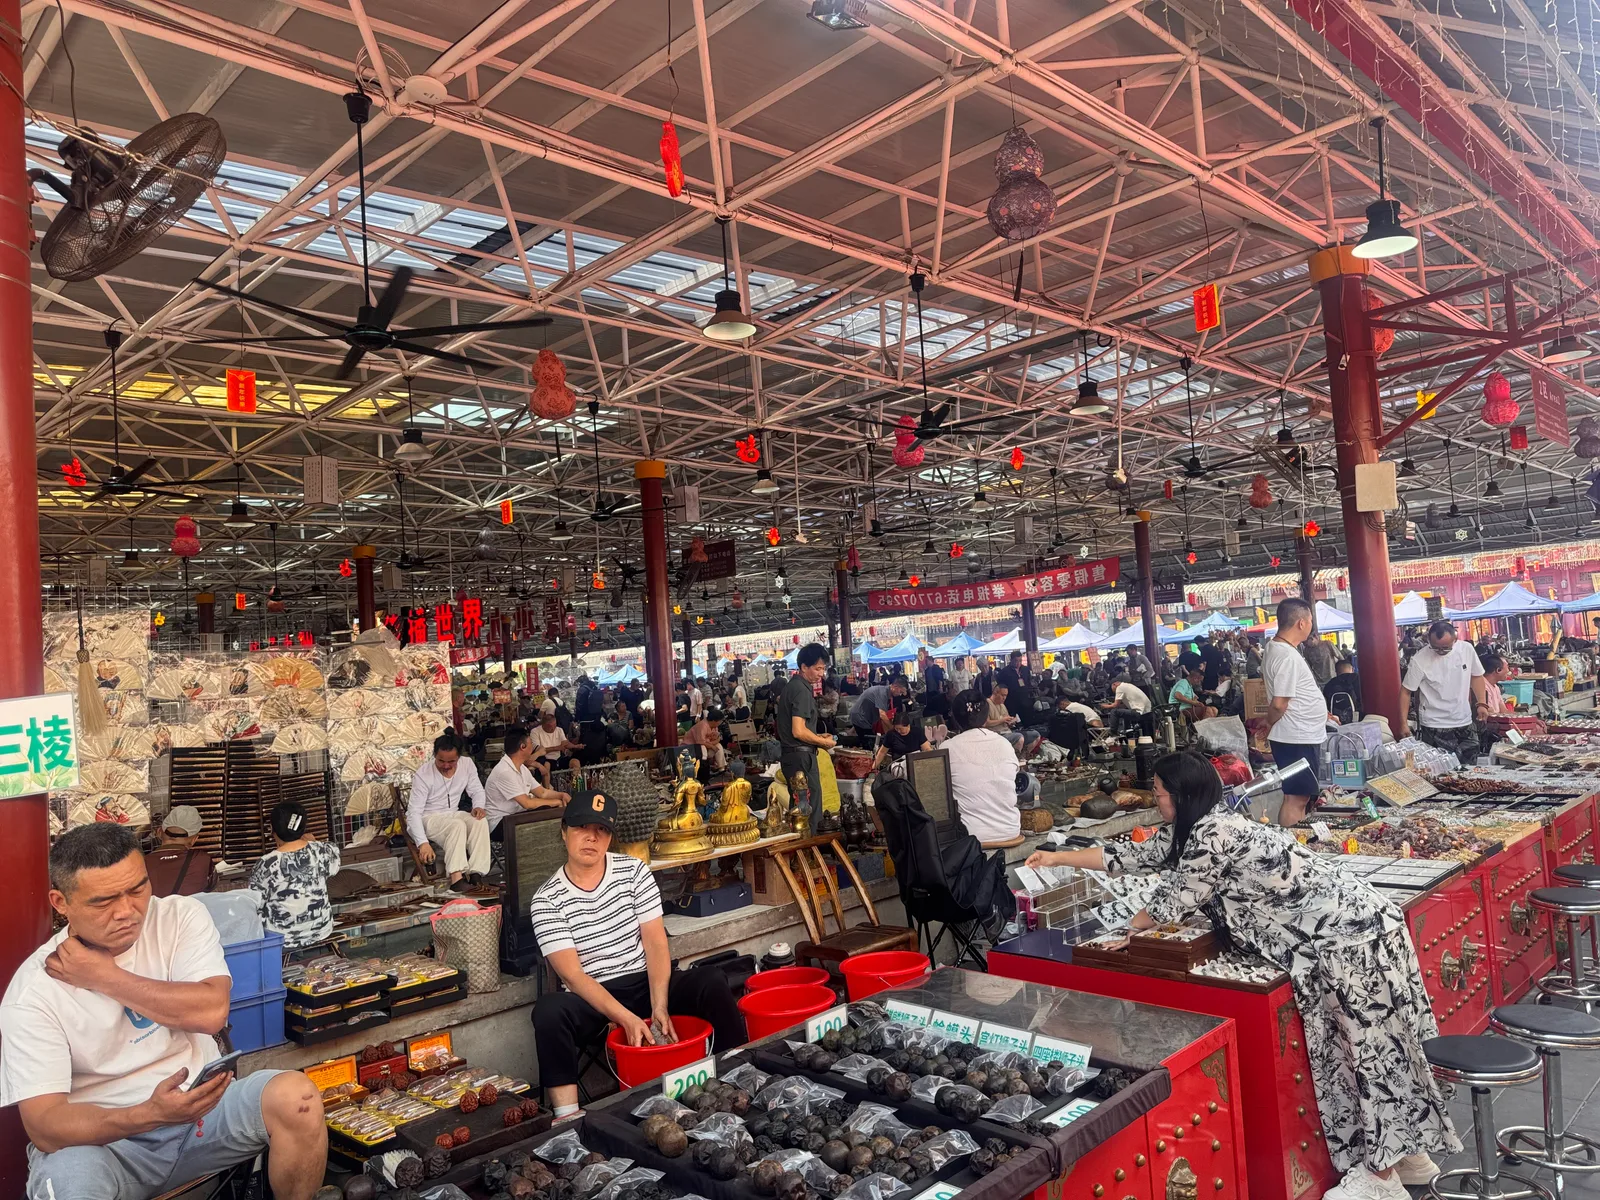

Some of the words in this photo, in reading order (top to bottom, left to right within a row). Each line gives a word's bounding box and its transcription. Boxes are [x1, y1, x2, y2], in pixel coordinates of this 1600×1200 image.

[0, 714, 75, 775] 三棱
[592, 794, 606, 812] G
[815, 1016, 842, 1040] 100
[673, 1069, 708, 1100] 200
[1059, 1104, 1093, 1122] 100
